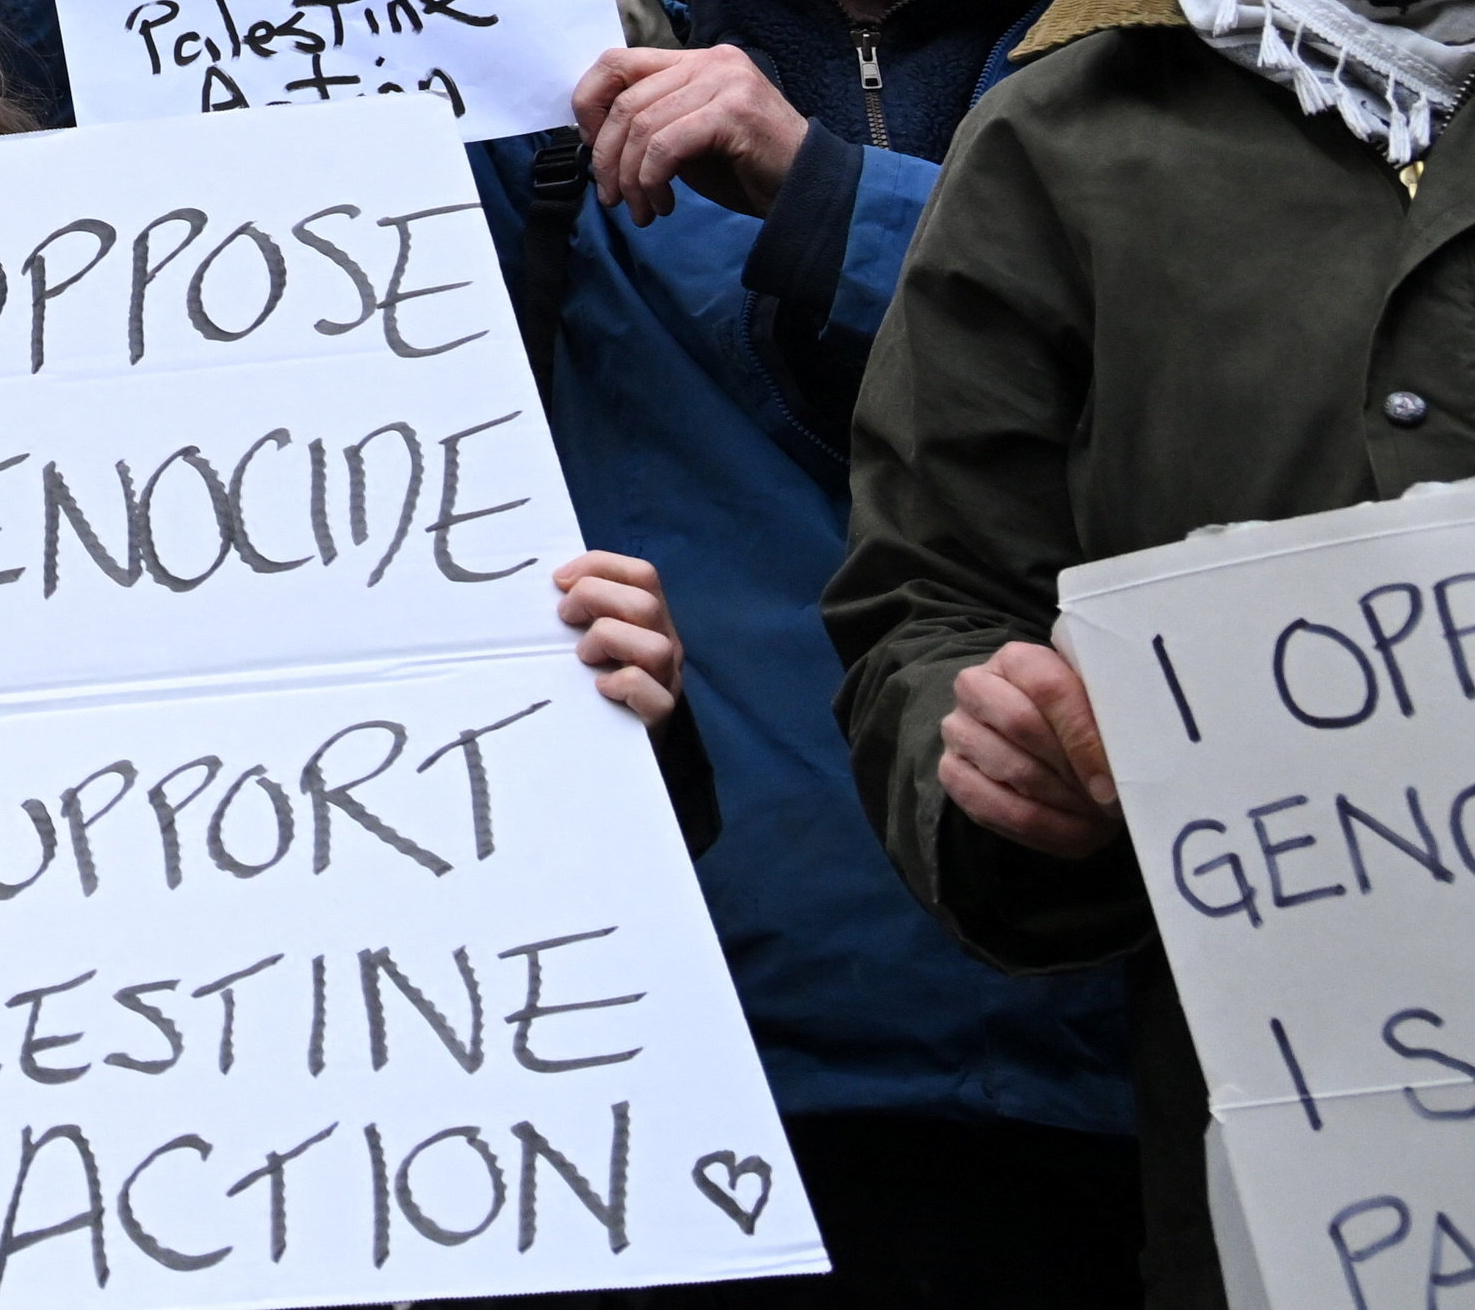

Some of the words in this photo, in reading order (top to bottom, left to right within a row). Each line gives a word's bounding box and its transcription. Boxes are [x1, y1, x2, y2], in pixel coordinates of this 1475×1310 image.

[1152, 633, 1202, 743] I
[1174, 785, 1475, 928] GEN
[1271, 1017, 1322, 1131] I
